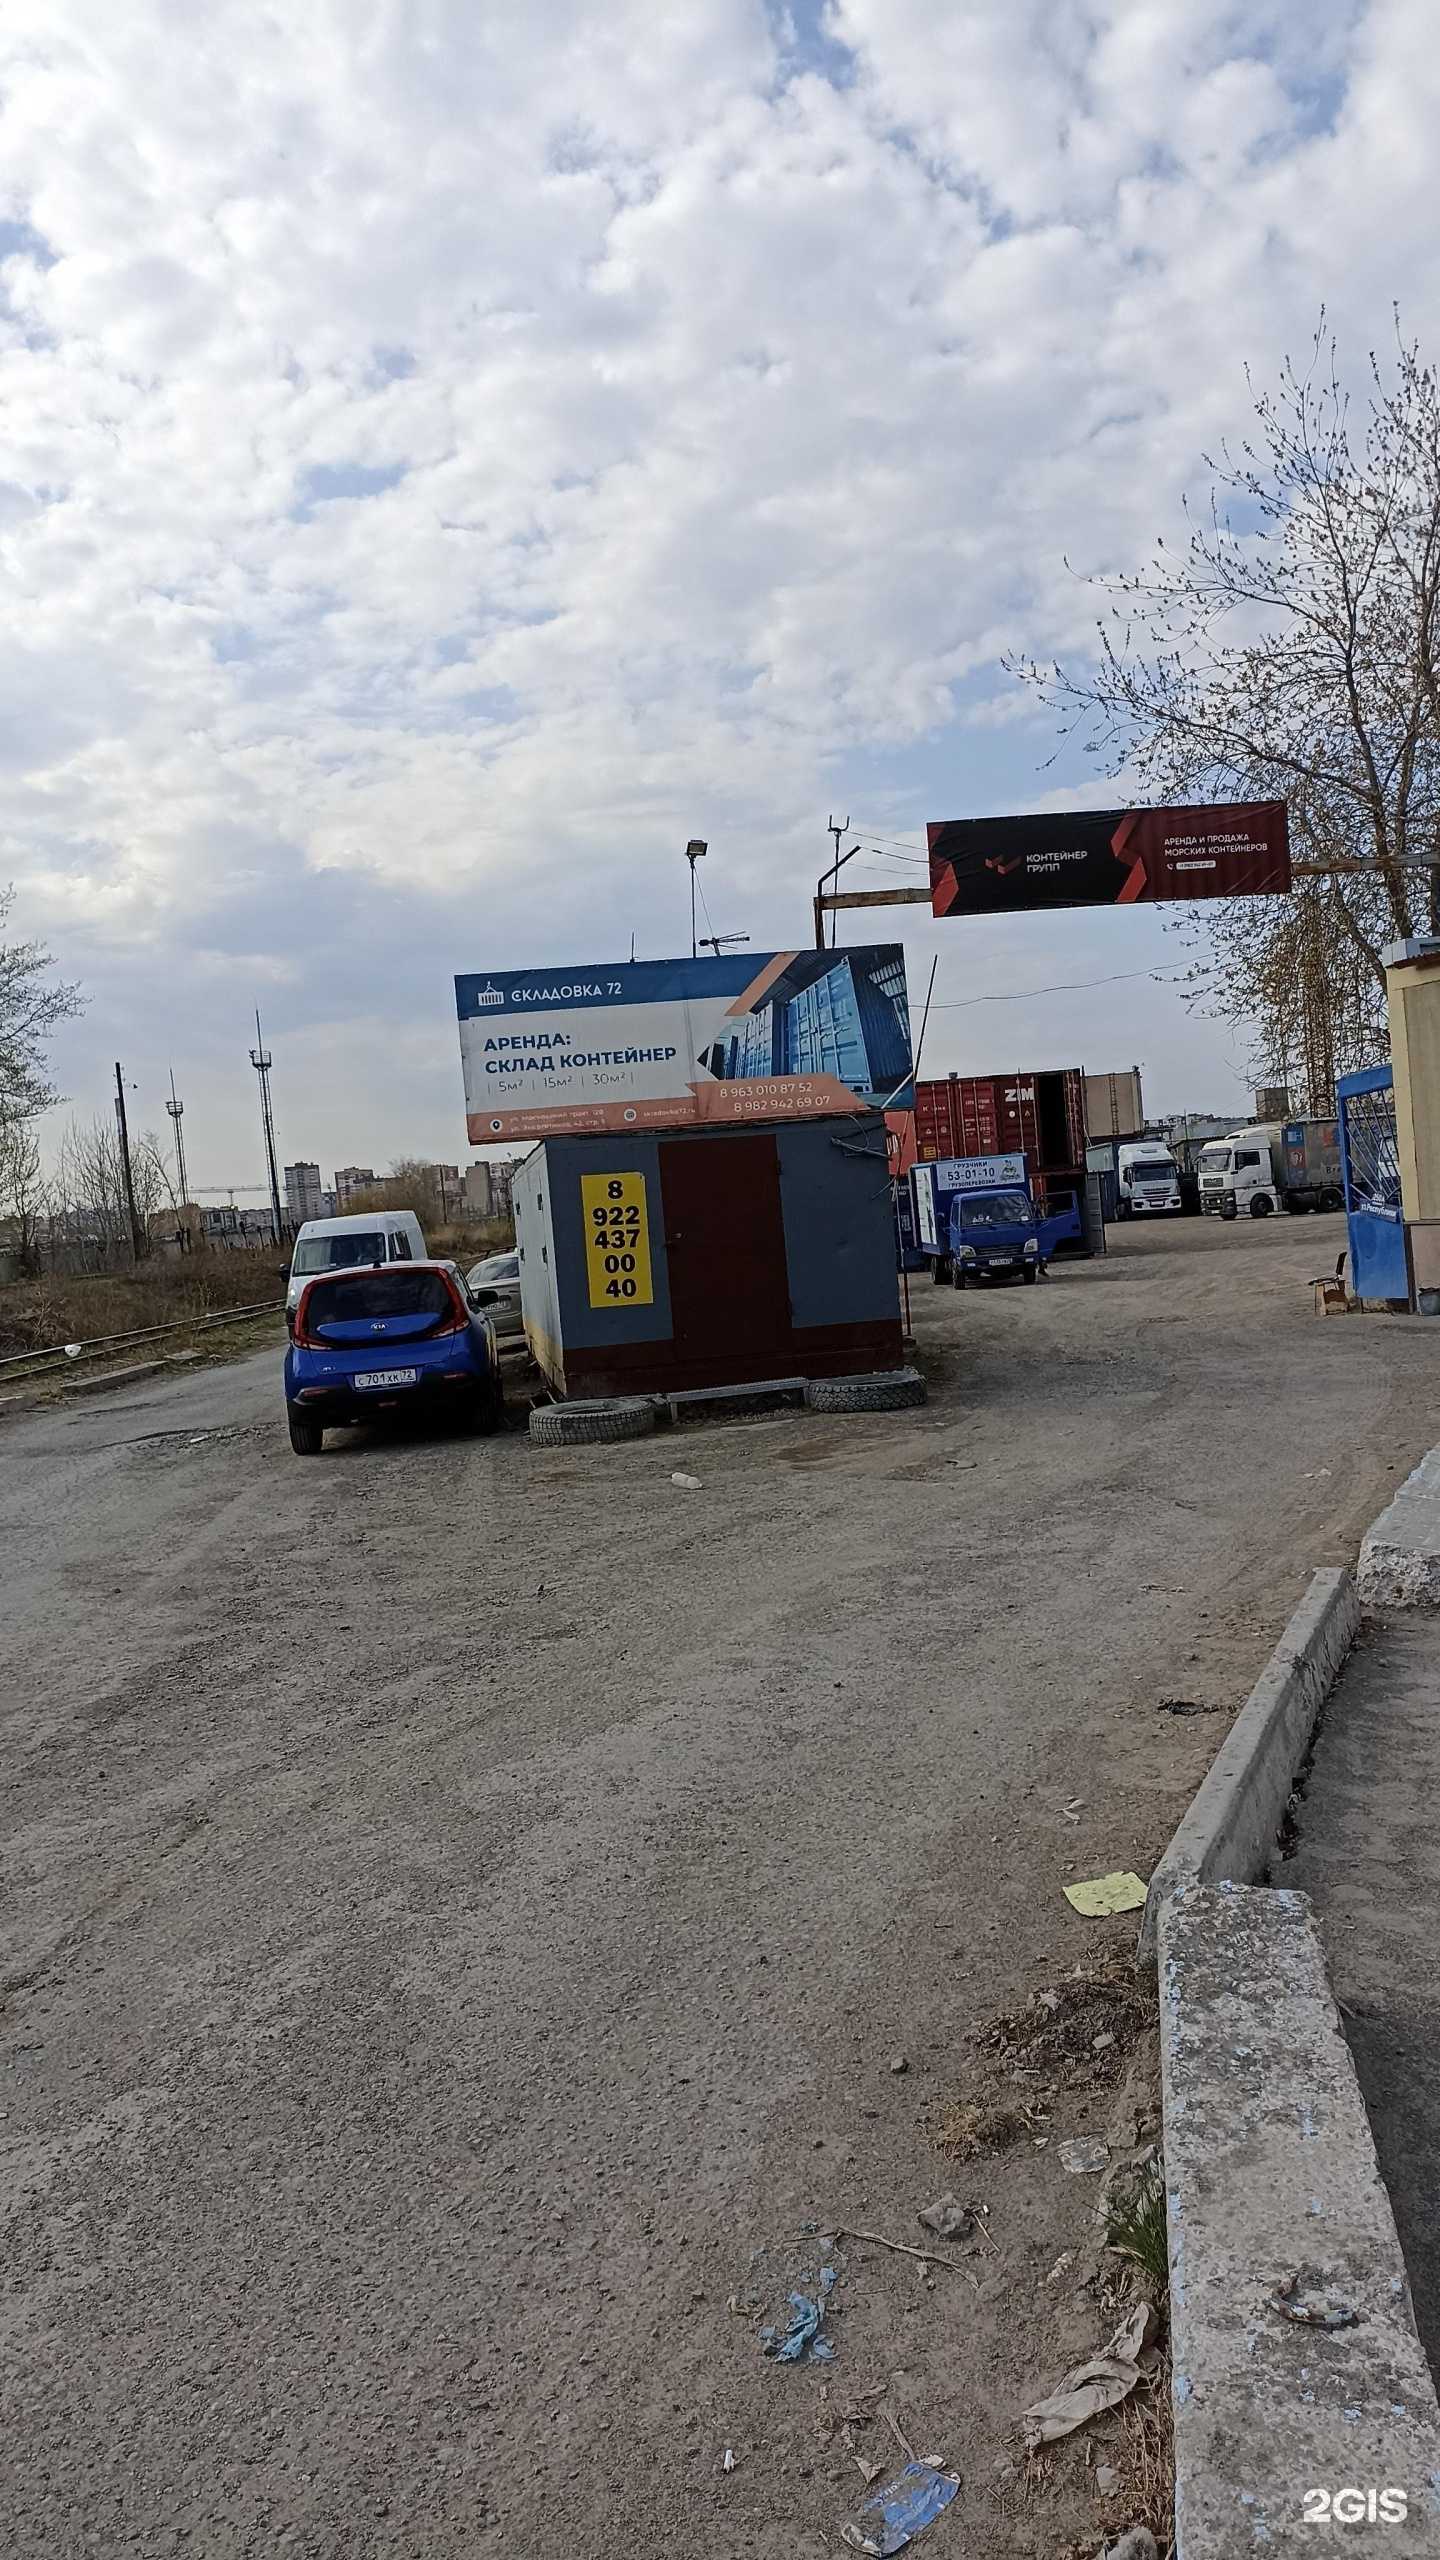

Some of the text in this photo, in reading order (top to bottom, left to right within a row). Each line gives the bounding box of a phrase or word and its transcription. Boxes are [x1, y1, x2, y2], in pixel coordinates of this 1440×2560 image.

[1164, 836, 1197, 846] АРЕНДА
[1207, 833, 1250, 845] ПРОДАЖА
[1026, 850, 1088, 863] КОНТЕЙНЕР
[1164, 843, 1268, 857] МОРСКИХ КОНТЕЙНЕРОВ
[1026, 862, 1060, 873] ГРУПП
[511, 982, 622, 1002] СКЛАДОВКА 72
[484, 1033, 572, 1051] АРЕНДА:
[485, 1046, 677, 1074] СКЛАД КОНТЕЙНЕР
[719, 1082, 813, 1098] 8 963 010 87 52
[1004, 1087, 1035, 1102] ZIM
[734, 1095, 831, 1112] 8 982 942 69 07
[953, 1160, 988, 1169] ГРУЗЧИКИ
[947, 1167, 995, 1181] 53-01-10
[608, 1180, 623, 1199] 8
[592, 1205, 640, 1226] 922
[594, 1229, 640, 1249] 437
[604, 1254, 636, 1273] 00
[606, 1278, 637, 1298] 40
[401, 1370, 412, 1379] 72
